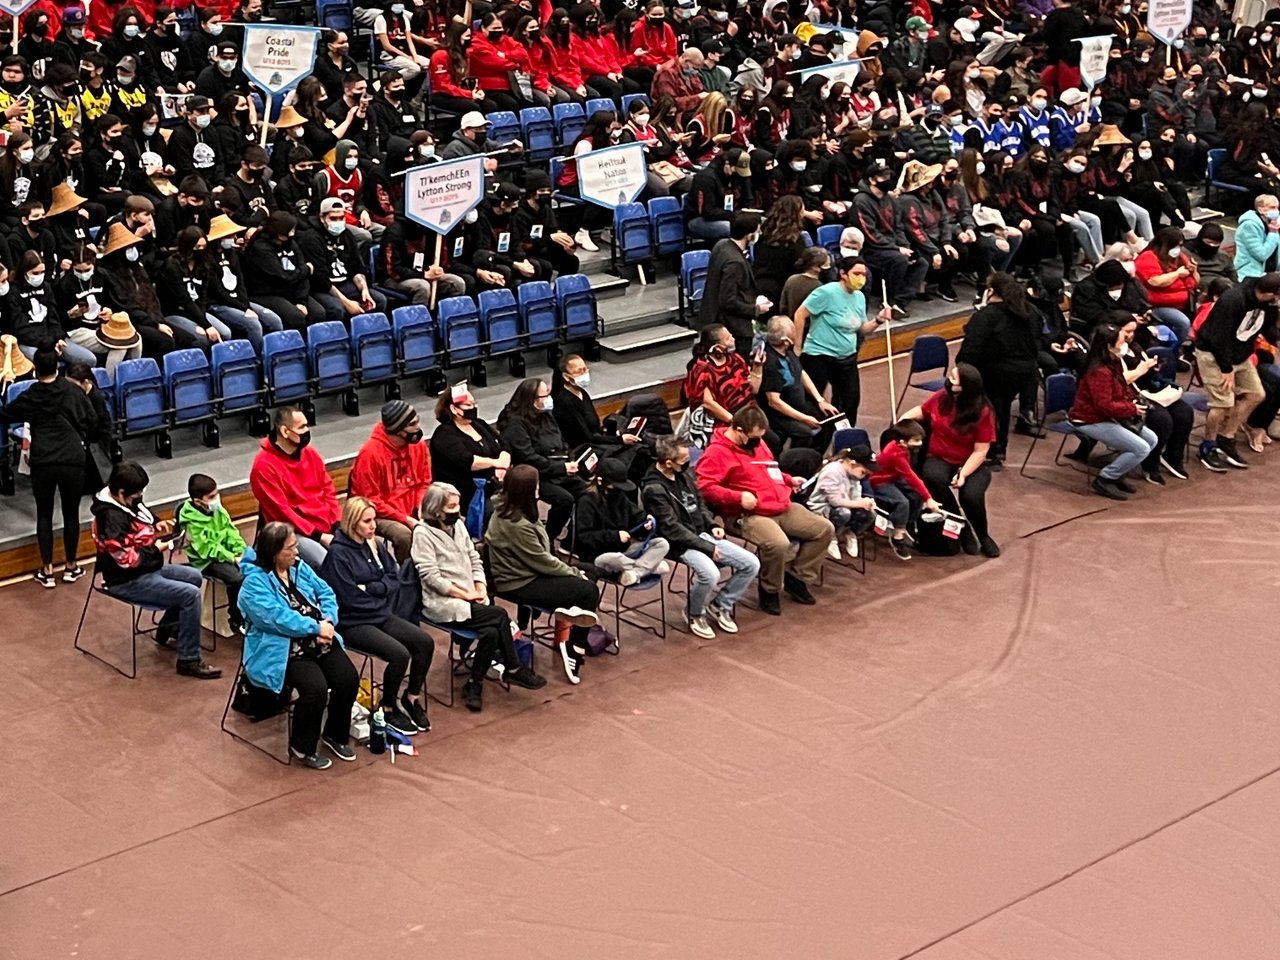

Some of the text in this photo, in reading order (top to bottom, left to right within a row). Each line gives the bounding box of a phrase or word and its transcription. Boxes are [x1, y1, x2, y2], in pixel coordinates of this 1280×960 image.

[265, 35, 296, 47] Coastal
[267, 46, 290, 58] Pride
[276, 58, 291, 66] BOYS
[417, 181, 472, 200] Lytton Strong
[443, 194, 460, 203] BOYS
